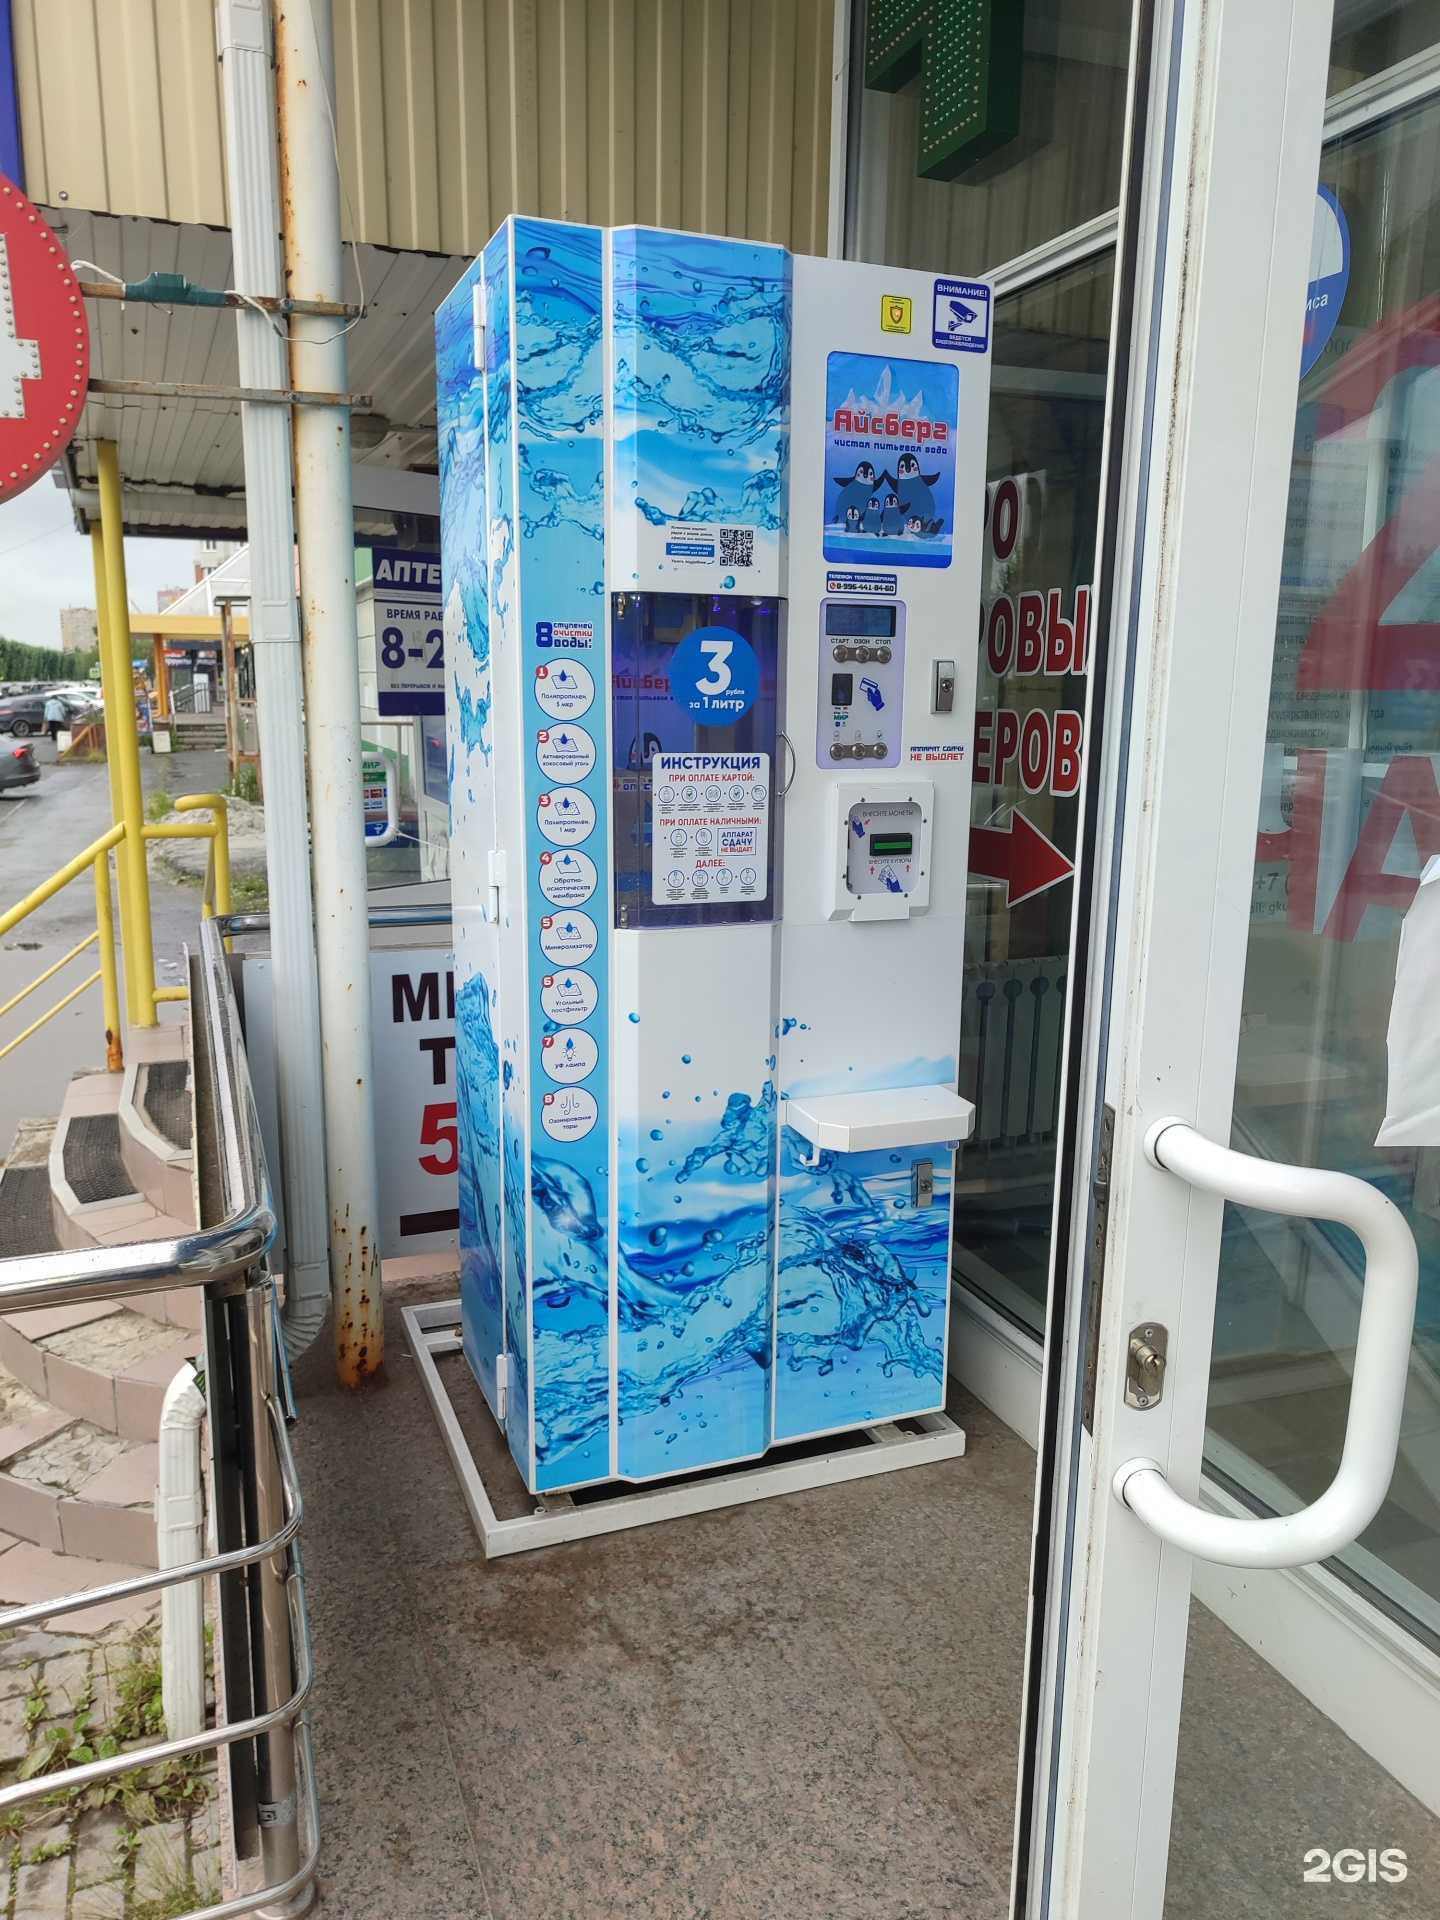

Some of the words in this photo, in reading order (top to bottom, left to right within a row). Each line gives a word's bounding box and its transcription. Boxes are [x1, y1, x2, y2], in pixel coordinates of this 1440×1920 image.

[937, 284, 987, 298] ВНИМАНИЕ!
[834, 409, 948, 443] Айсберг
[834, 439, 870, 449] чистая
[873, 442, 921, 453] питьевая
[925, 446, 947, 454] вода
[376, 559, 441, 585] АПТЕ
[386, 608, 420, 620] ВРЕМЯ
[536, 622, 553, 647] 8
[554, 637, 592, 648] воды:
[695, 640, 734, 696] 3
[726, 689, 745, 697] рубля
[703, 697, 709, 709] 1
[711, 699, 745, 712] литр
[661, 756, 760, 771] ИНСТРУКЦИЯ
[669, 774, 686, 783] ПРИ
[688, 773, 719, 782] ОПЛАТЕ
[721, 771, 755, 781] КАРТОЙ:
[660, 818, 675, 826] ПРИ
[678, 817, 707, 826] ОПЛАТЕ
[709, 817, 761, 825] НАЛИЧНЫМИ:
[722, 838, 753, 847] СДАЧУ
[695, 859, 726, 869] ДАЛЕЕ:
